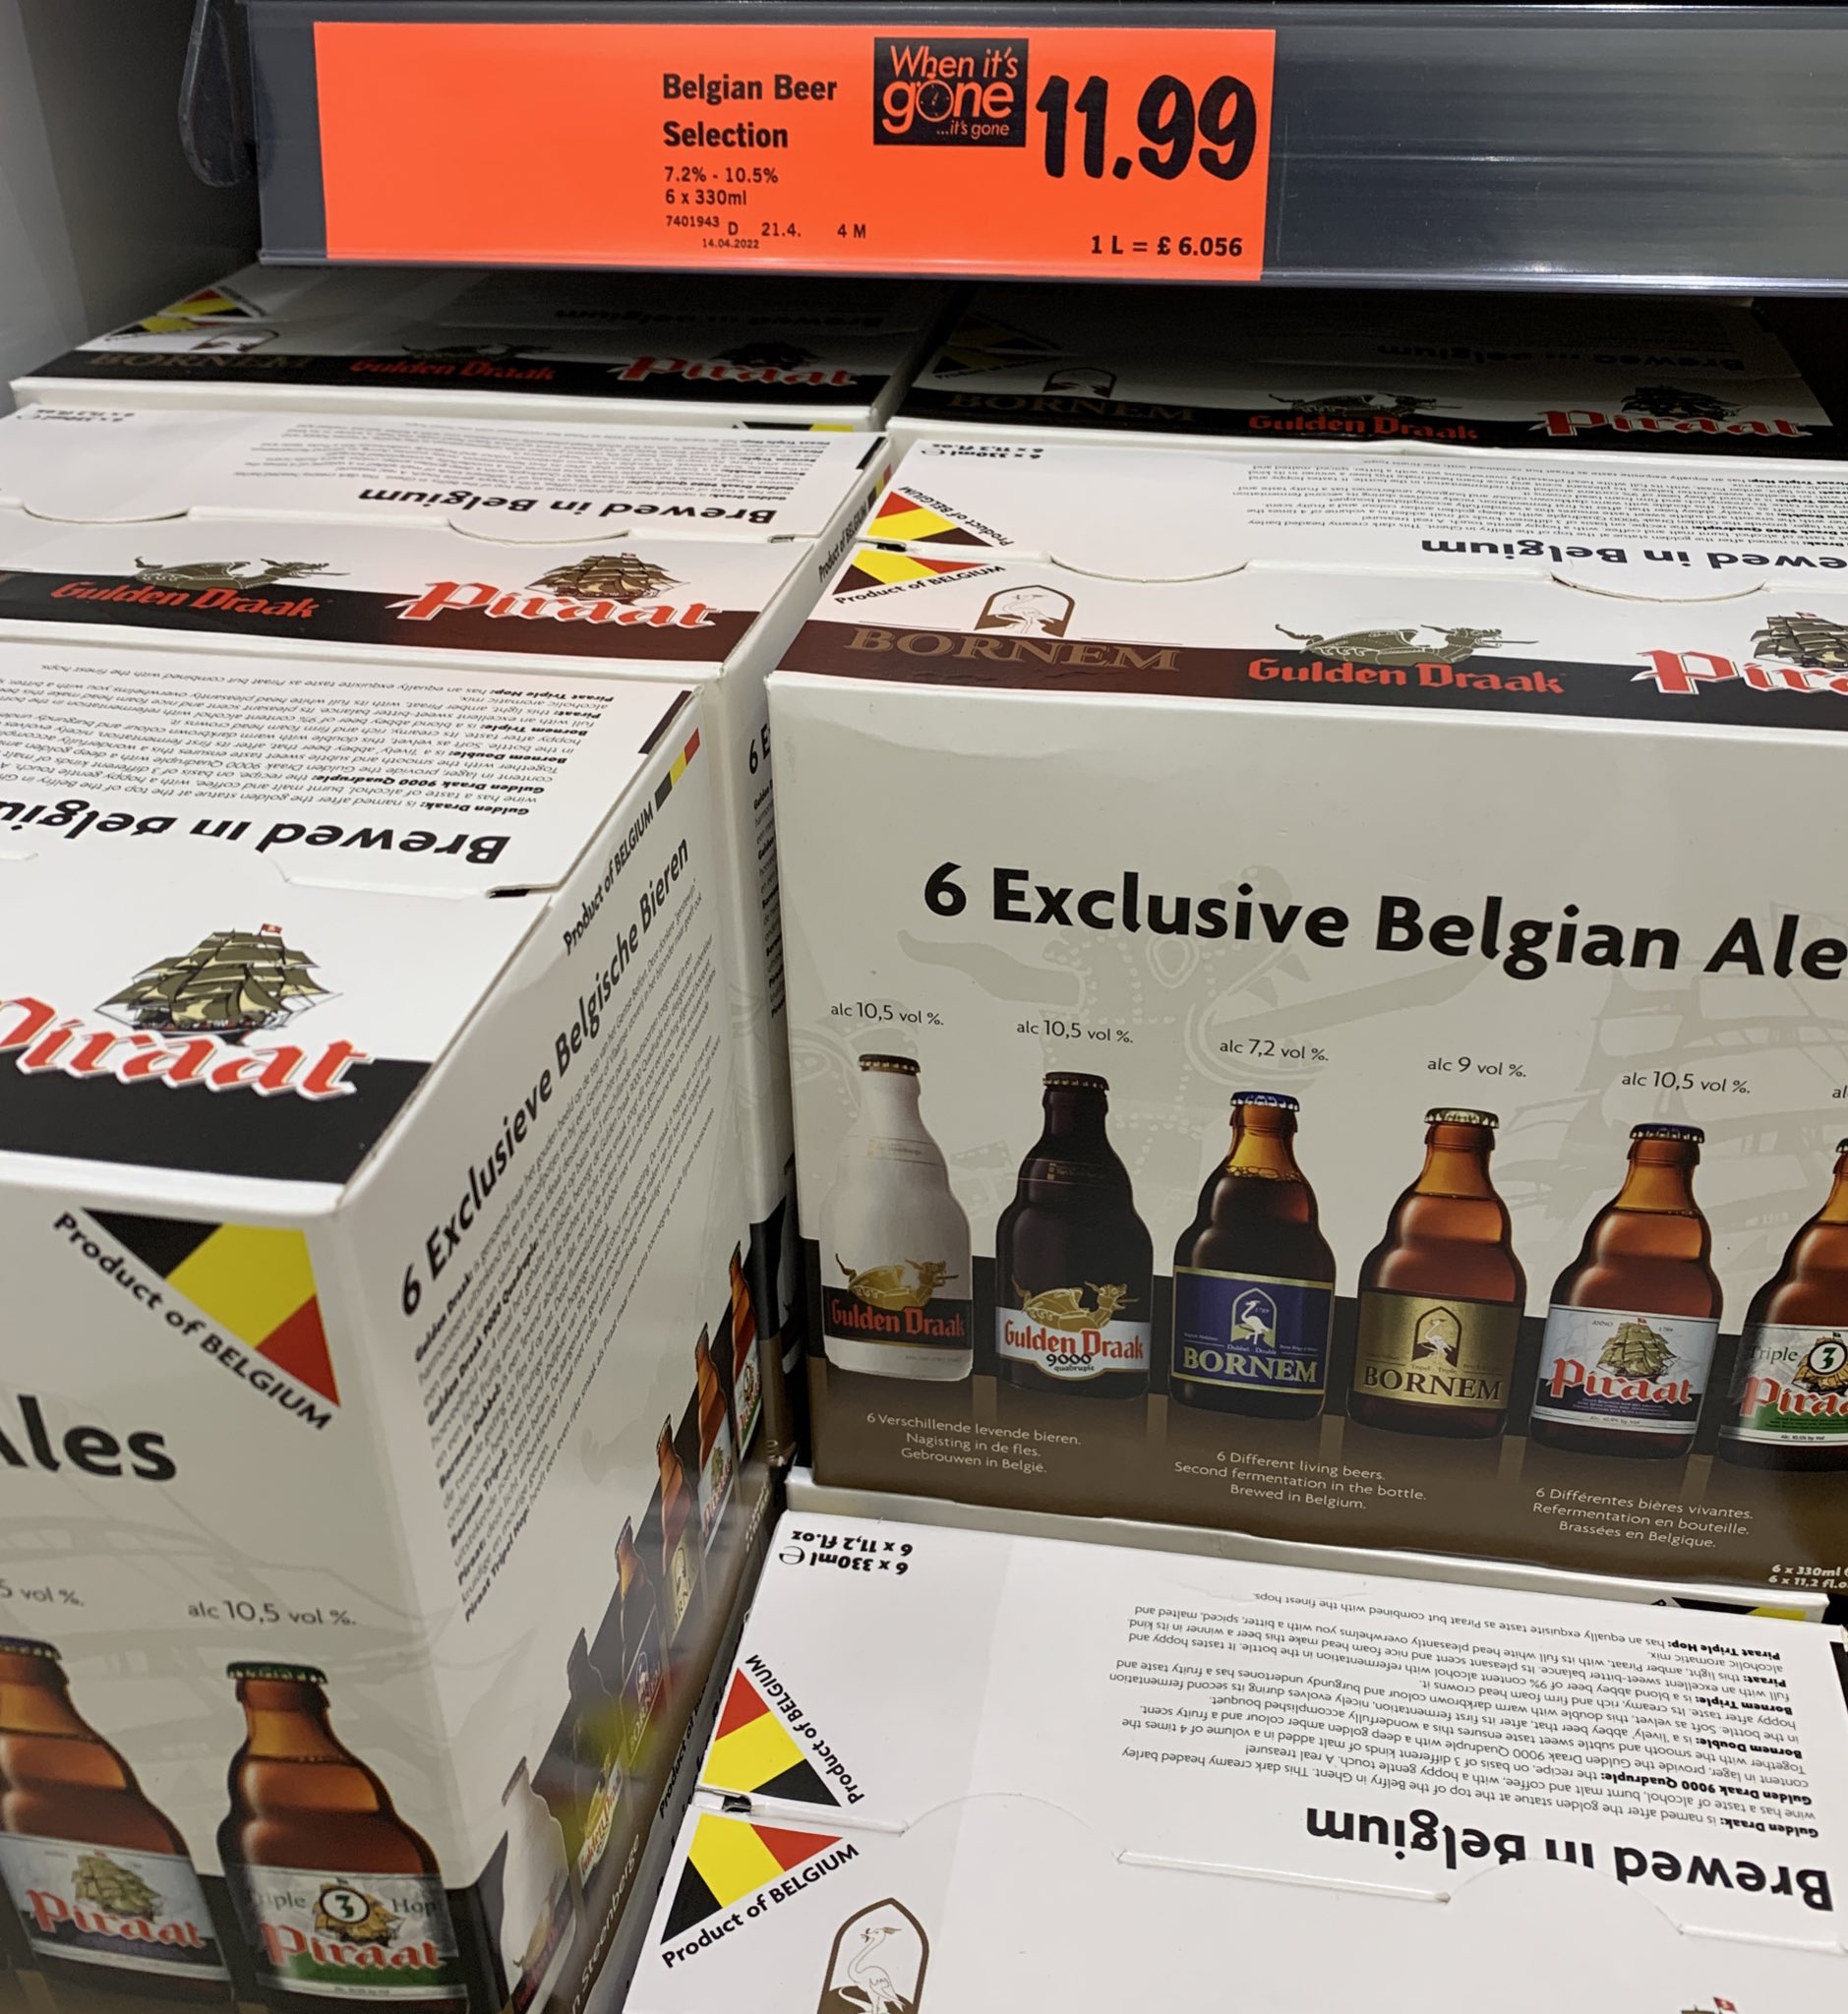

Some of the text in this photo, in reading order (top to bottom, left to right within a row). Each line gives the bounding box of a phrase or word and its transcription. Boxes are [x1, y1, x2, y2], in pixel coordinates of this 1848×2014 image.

[890, 45, 1019, 79] When it's
[663, 74, 839, 105] Belgian Beer
[882, 79, 1015, 135] gone
[663, 121, 789, 148] Selection
[971, 122, 1010, 141] gone
[1036, 75, 1257, 181] 11.99
[664, 166, 778, 184] 7.2% 10.5%
[665, 189, 747, 206] 6 x 330ml
[666, 215, 720, 227] 7401943
[728, 222, 866, 239] D 21.4. 4 M
[702, 239, 759, 249] 14.04.2022
[1091, 235, 1243, 257] 1 L £ 6.056
[607, 355, 859, 387] Piraat
[946, 392, 1195, 423] BORNEM
[1248, 414, 1478, 441] Gulden Draak
[1527, 409, 1813, 439] Piraat
[358, 488, 777, 525] Brewed in Belgium
[834, 564, 1007, 605] Product of BELGIUM
[50, 581, 321, 620] Gulden Draak
[385, 579, 725, 629] Piraat
[843, 626, 1180, 673] BORNEM
[1247, 657, 1566, 694] Gulden Draak
[189, 816, 512, 865] Brewed in
[563, 800, 655, 957] Product of BELGIUM
[923, 861, 1848, 981] 6 Exclusive Belgian Ale
[1220, 1039, 1244, 1054] alc
[1248, 1038, 1276, 1058] 7,2
[1281, 1045, 1306, 1060] vol
[401, 837, 690, 1318] 6 Exclusieve Belgische Bieren
[1427, 1057, 1453, 1072] alc
[1458, 1056, 1471, 1073] 9
[1477, 1062, 1503, 1076] vol
[1622, 1072, 1647, 1087] alc
[1653, 1071, 1695, 1092] 10,5
[1700, 1079, 1727, 1093] vol
[53, 1212, 332, 1432] Product of BELGIUM
[831, 1298, 965, 1338] Gulden Draak
[1003, 1319, 1145, 1360] Gulden Draak
[1046, 1353, 1093, 1367] 9000
[1182, 1345, 1318, 1384] BORNEM
[1362, 1365, 1504, 1401] BORNEM
[1544, 1357, 1694, 1405] Piraat
[865, 1412, 1082, 1446] 6 Verschillende levende bieren.
[906, 1432, 1042, 1456] Nagisting in de fles.
[901, 1448, 983, 1466] Gebrouwen
[985, 1456, 998, 1467] in
[1217, 1451, 1386, 1481] 6 Different living beers.
[1174, 1461, 1427, 1501] Second fermentation in the bottle.
[1230, 1484, 1367, 1510] Brewed in Belgium.
[1535, 1487, 1755, 1520] 6 Différentes bières vivantes.
[1532, 1502, 1751, 1535] Refermentation en bouteille.
[791, 1529, 914, 1557] 6 x 11,2 fl.oz
[1559, 1520, 1716, 1549] Brassées en Belgique.
[808, 1551, 909, 1576] 6 x 330ml
[1771, 1564, 1781, 1573] 6
[1796, 1566, 1841, 1576] 330ml
[1768, 1574, 1778, 1583] 6
[1793, 1576, 1818, 1587] 11,2
[1667, 1638, 1780, 1661] Piraat Triple Hop:
[1743, 1674, 1787, 1688] Piraat:
[1695, 1696, 1793, 1715] Bornem Triple:
[745, 1653, 865, 1806] Product of BELGIUM
[1696, 1738, 1802, 1759] Bornem Double:
[1600, 1771, 1813, 1806] Gulden Draak 9000 Quadruple:
[1719, 1817, 1819, 1839] Gulden Draak:
[1305, 1807, 1835, 1912] Brewed in Belgium
[24, 1887, 209, 1951] Piraat
[392, 1897, 439, 1921] Hop
[661, 1843, 861, 1969] Product of BELGIUM
[259, 1922, 450, 1974] Piraat
